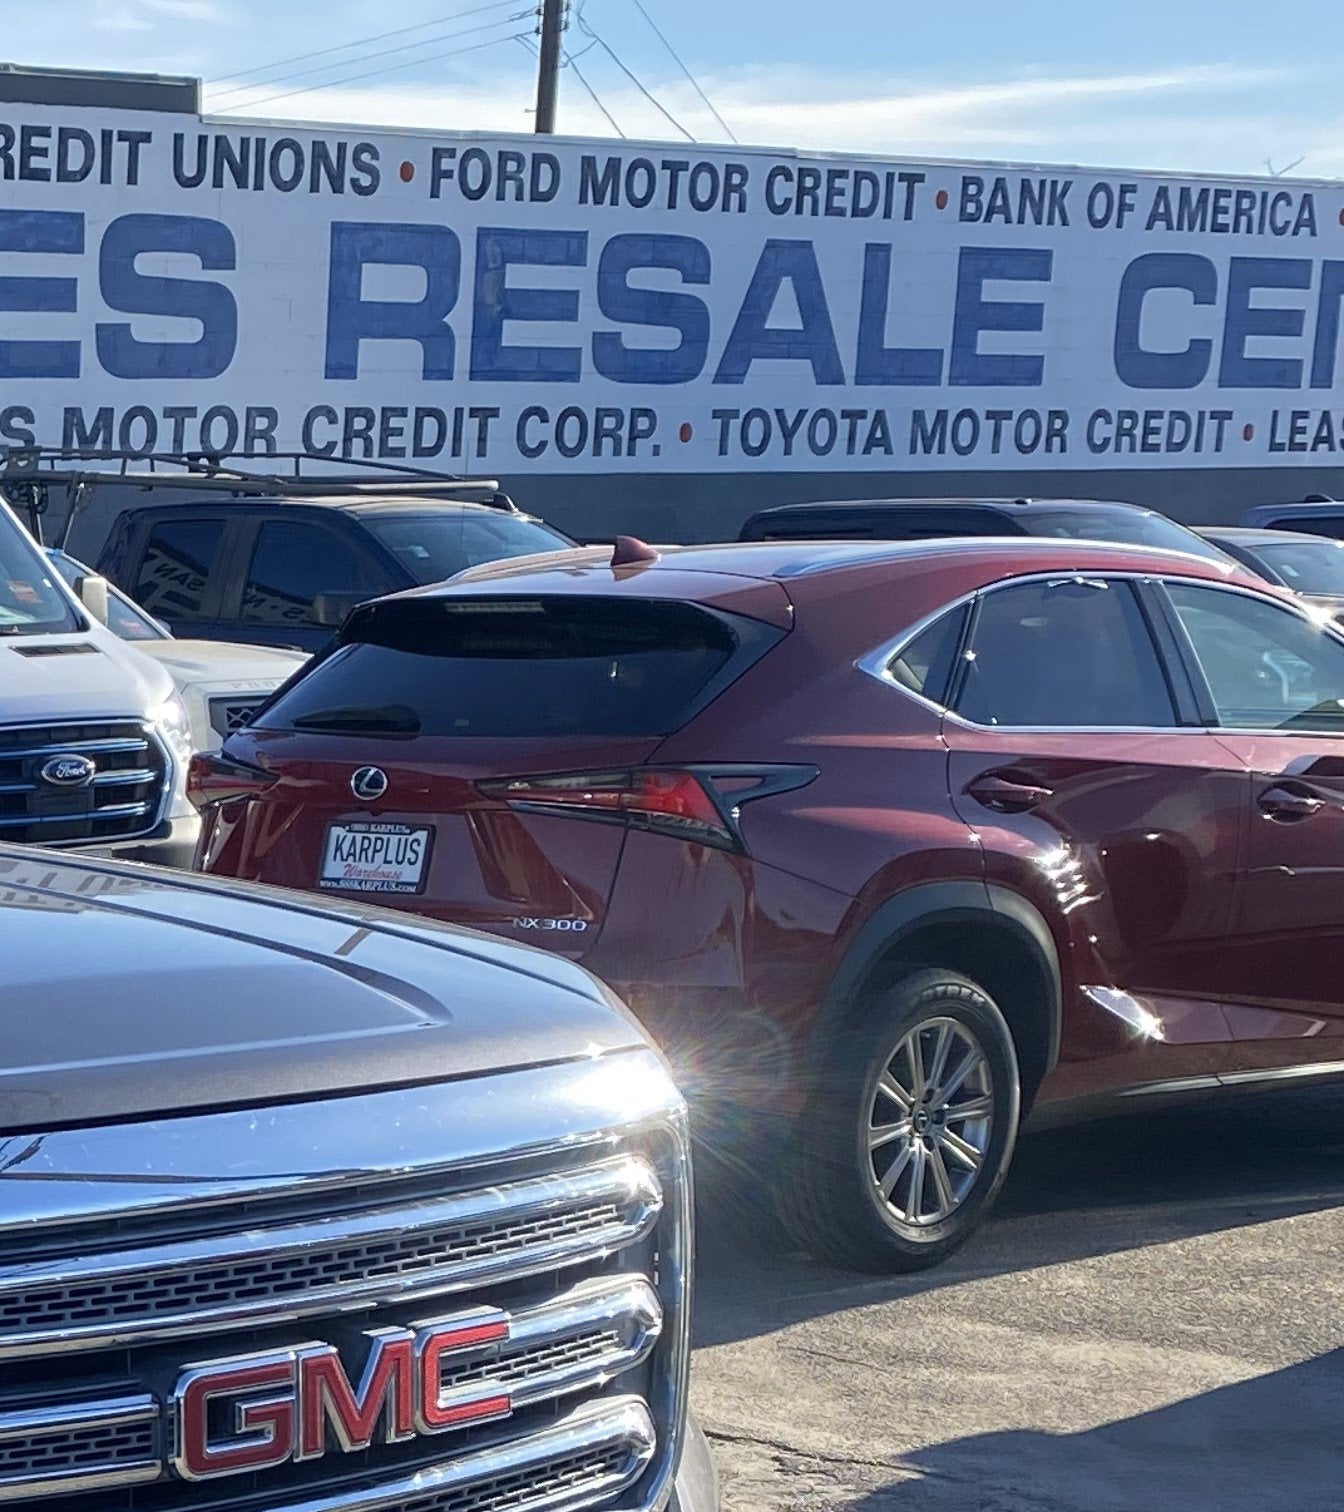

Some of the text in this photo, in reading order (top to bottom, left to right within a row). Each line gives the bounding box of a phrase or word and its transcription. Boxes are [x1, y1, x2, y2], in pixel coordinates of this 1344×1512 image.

[172, 133, 381, 197] UNIONS
[429, 147, 926, 221] FORD MOTOR CREDIT
[959, 176, 1318, 237] BANK OF AMERICA
[325, 221, 1053, 387] RESALE
[62, 404, 279, 453] MOTOR
[301, 404, 500, 458] CREDIT
[516, 405, 661, 458] CORP.
[712, 407, 1233, 457] TOYOTA MOTOR CREDIT
[1268, 409, 1344, 452] LEA
[55, 761, 86, 778] Ford
[333, 834, 421, 866] KARPLUS
[173, 1307, 513, 1482] GMC
